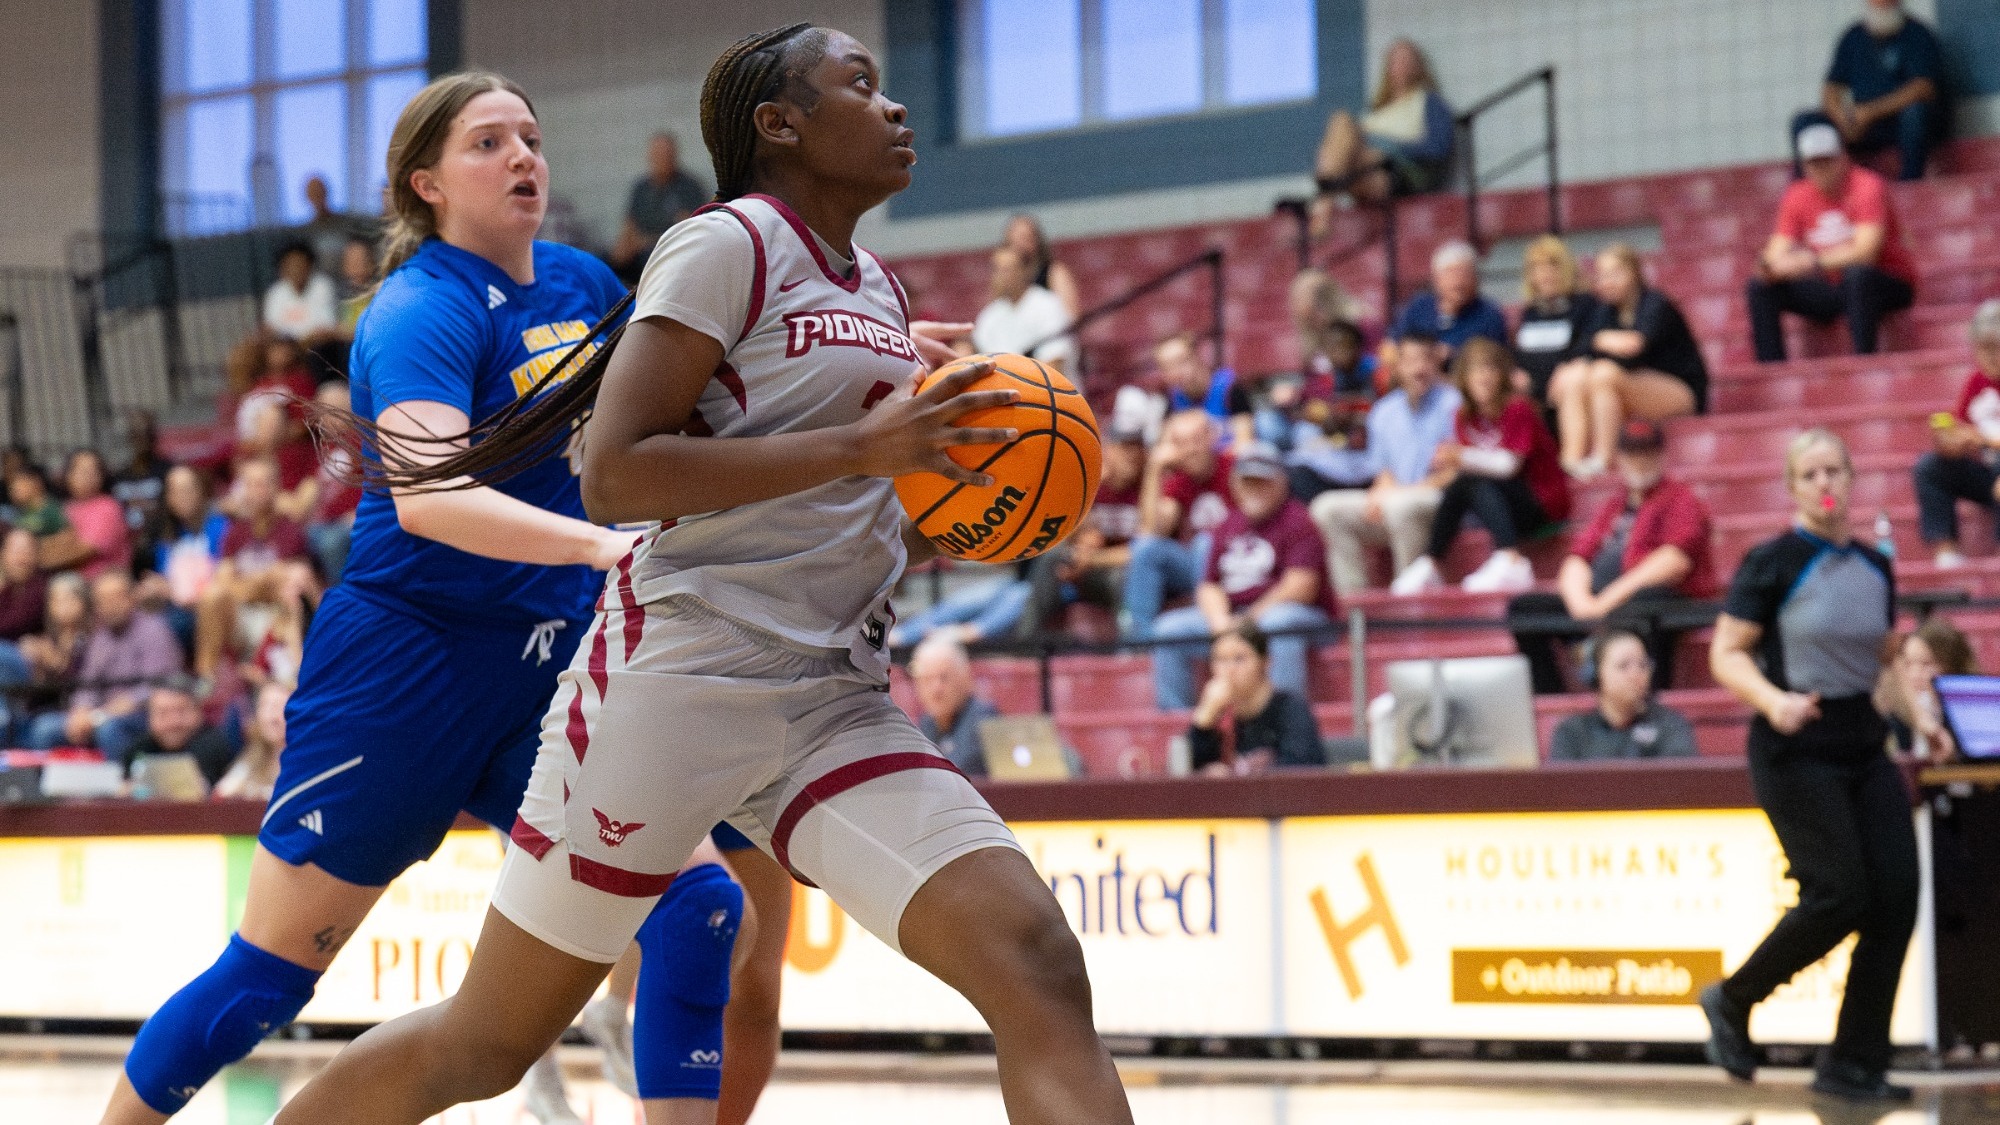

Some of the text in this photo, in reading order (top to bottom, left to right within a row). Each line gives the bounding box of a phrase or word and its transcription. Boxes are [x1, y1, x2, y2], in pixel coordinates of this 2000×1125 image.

[929, 485, 1027, 555] Wilson
[1014, 515, 1067, 559] CAA
[601, 829, 624, 842] TWU
[1445, 844, 1725, 879] HOULIHAN'S
[1502, 958, 1691, 995] Outdoor Patio
